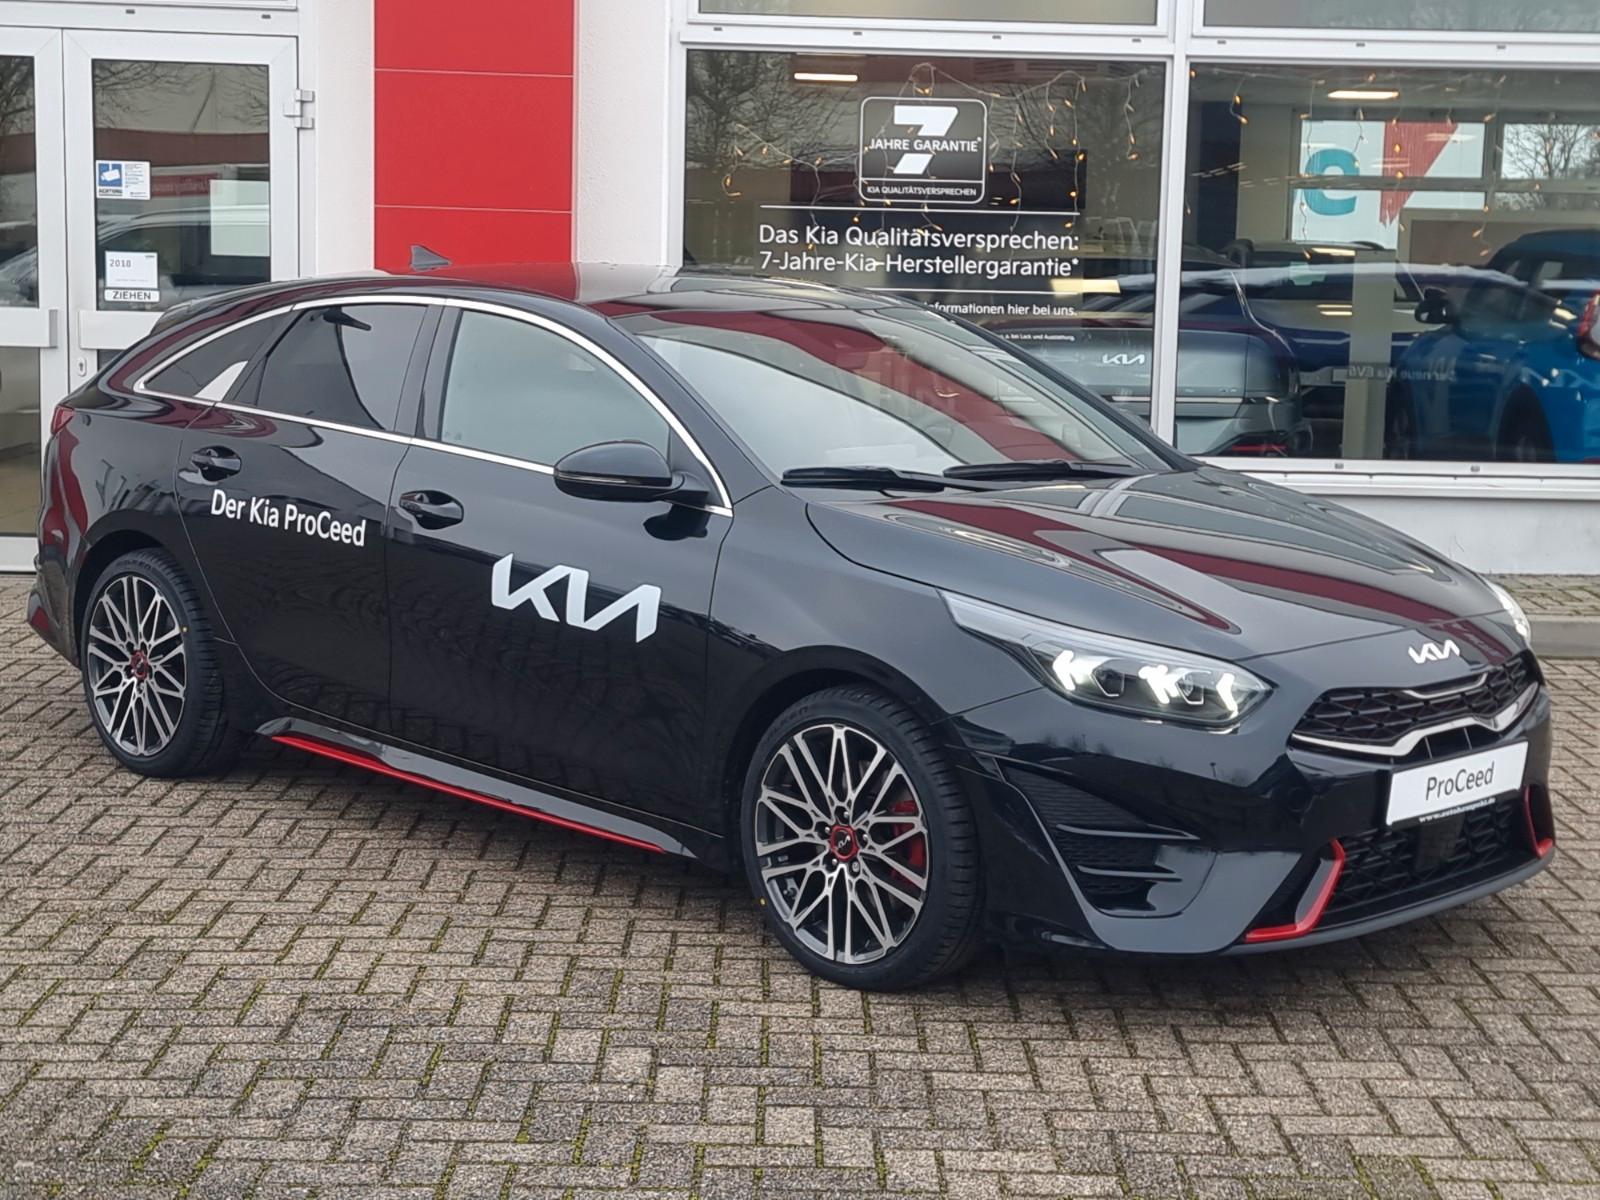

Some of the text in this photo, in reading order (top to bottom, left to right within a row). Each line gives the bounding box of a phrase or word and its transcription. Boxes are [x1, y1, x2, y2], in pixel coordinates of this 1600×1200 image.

[869, 138, 909, 150] JAHRE
[867, 185, 977, 196] KIA QUALITÄTSVERSPRECHEN
[759, 224, 798, 244] Das
[805, 226, 838, 245] Kia
[845, 226, 1079, 252] Qualitätsversprechen:
[112, 290, 152, 300] ZIEHEN
[924, 302, 1078, 317] formationen hier bei uns.
[210, 489, 367, 547] Der Kia ProCeed
[491, 553, 662, 643] KIA
[1408, 639, 1460, 664] KIA
[1425, 761, 1495, 801] ProCeed
